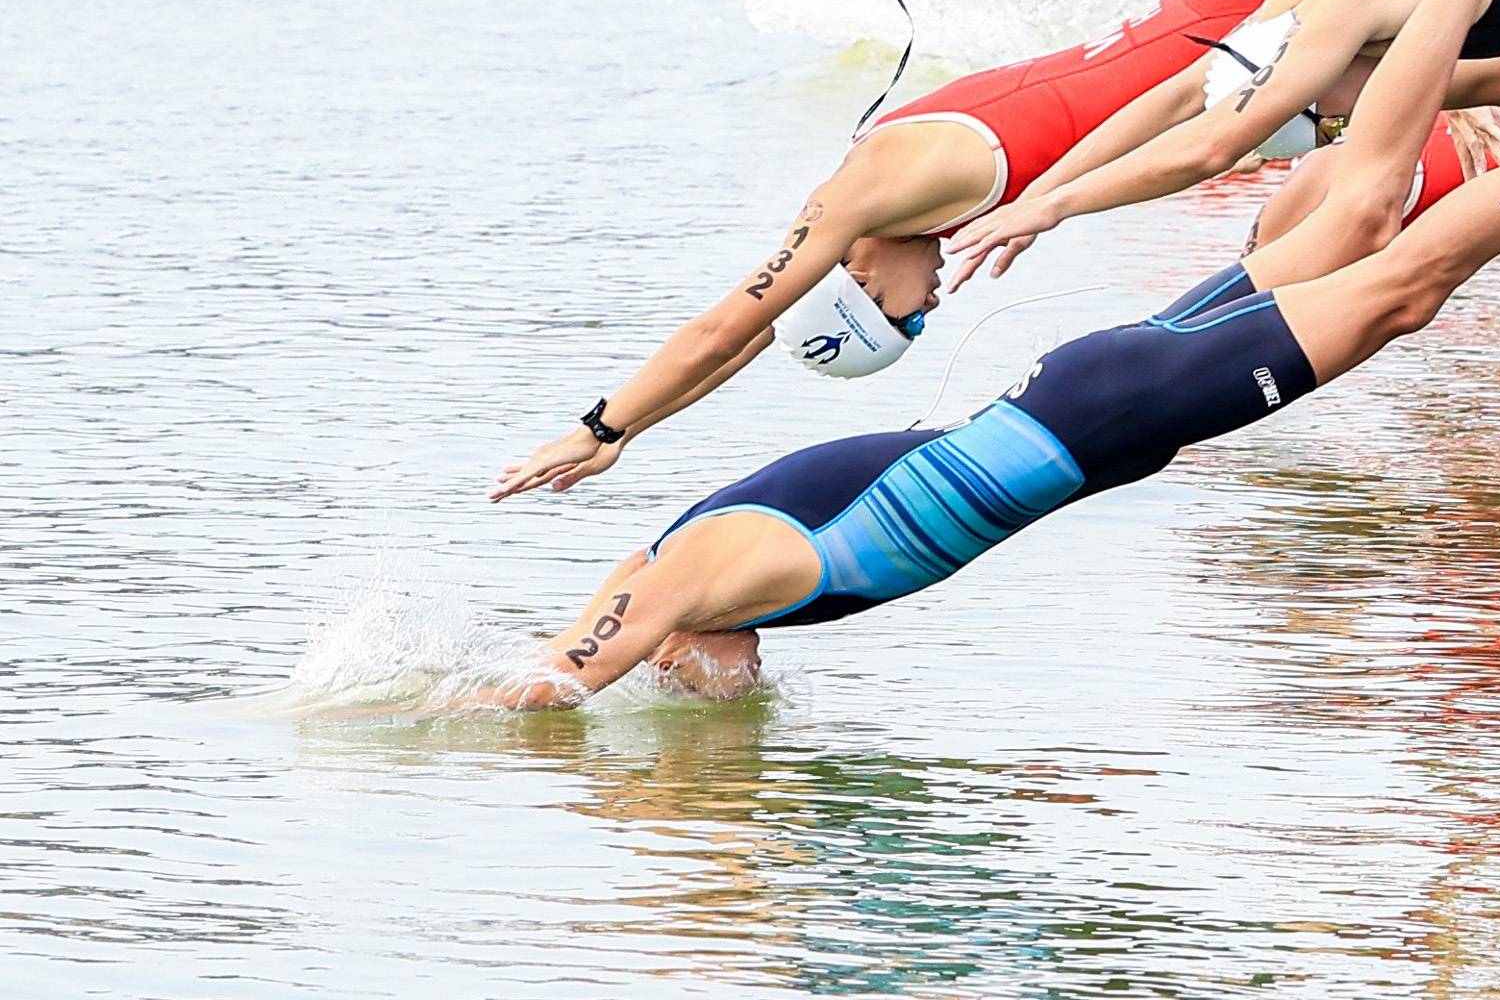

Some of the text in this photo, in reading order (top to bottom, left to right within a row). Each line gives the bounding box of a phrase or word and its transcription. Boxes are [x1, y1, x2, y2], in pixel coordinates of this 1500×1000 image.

[1234, 41, 1289, 114] 101
[744, 225, 811, 301] 132
[565, 591, 633, 670] 102
